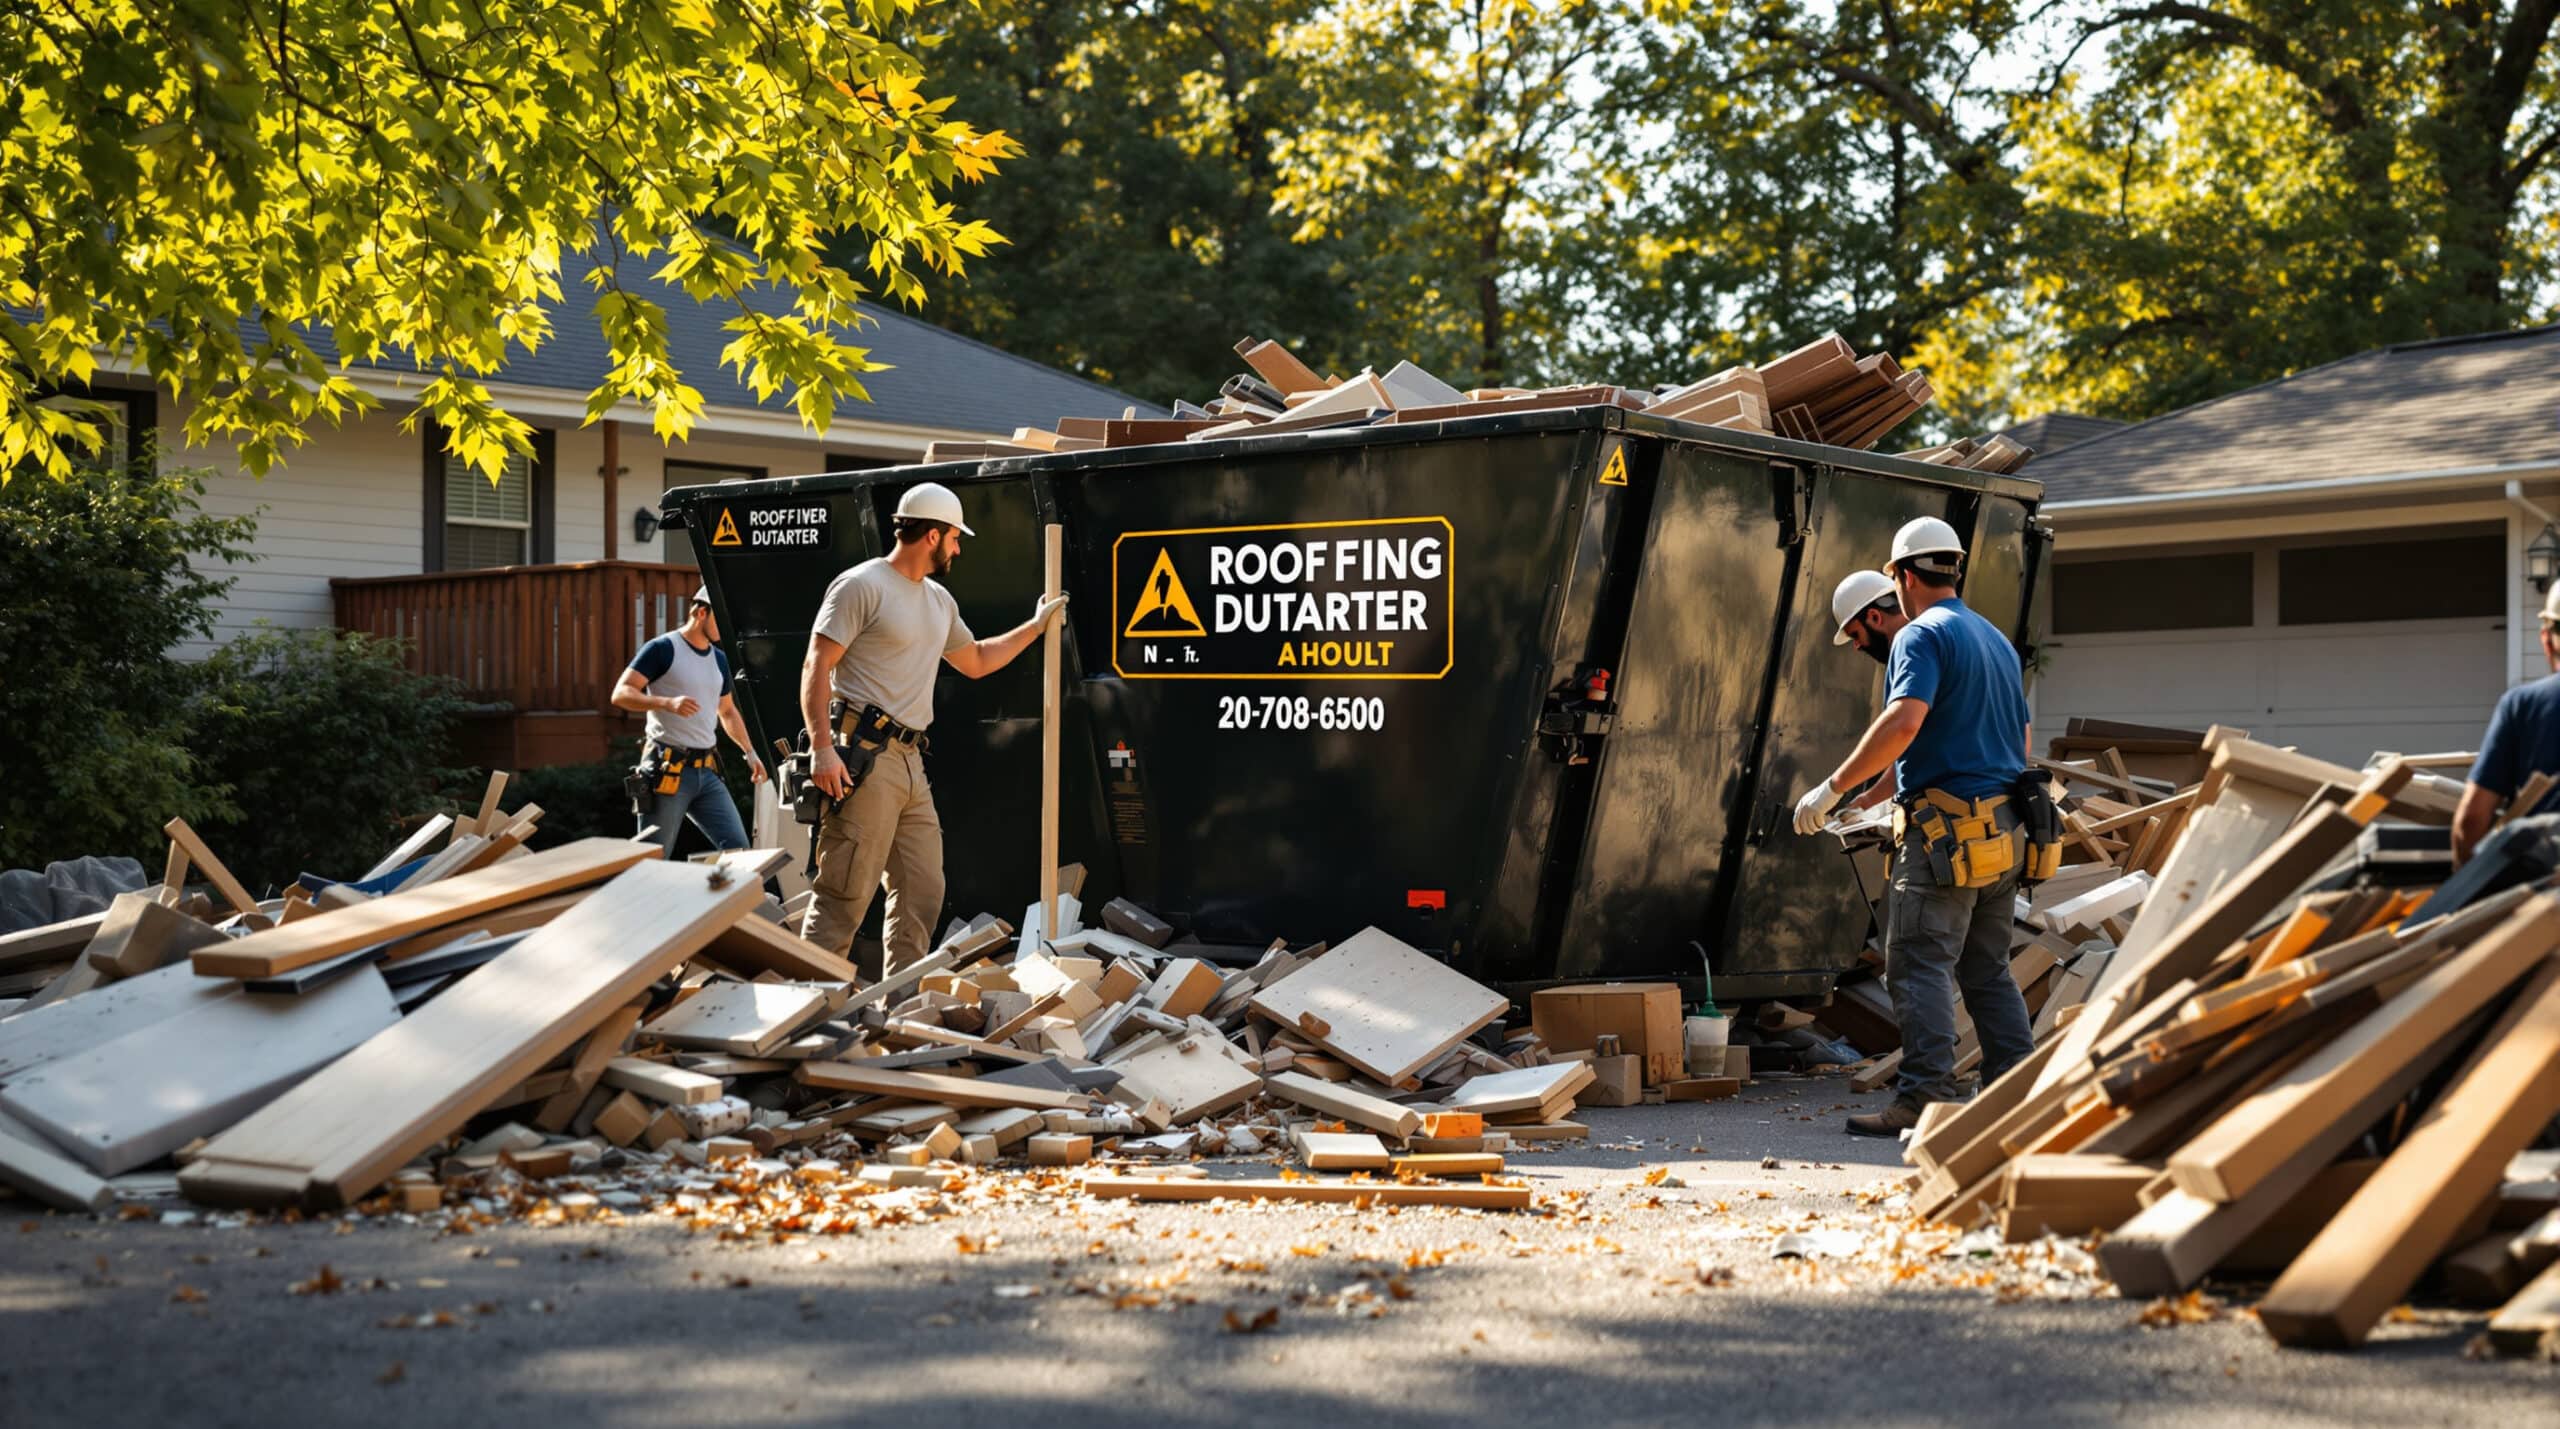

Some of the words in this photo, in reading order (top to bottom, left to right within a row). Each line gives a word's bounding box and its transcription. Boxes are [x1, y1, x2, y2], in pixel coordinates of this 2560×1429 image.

[752, 529, 818, 545] DUTARTER
[1215, 590, 1428, 632] DUTARTER
[1218, 696, 1385, 731] 20-708-6500
